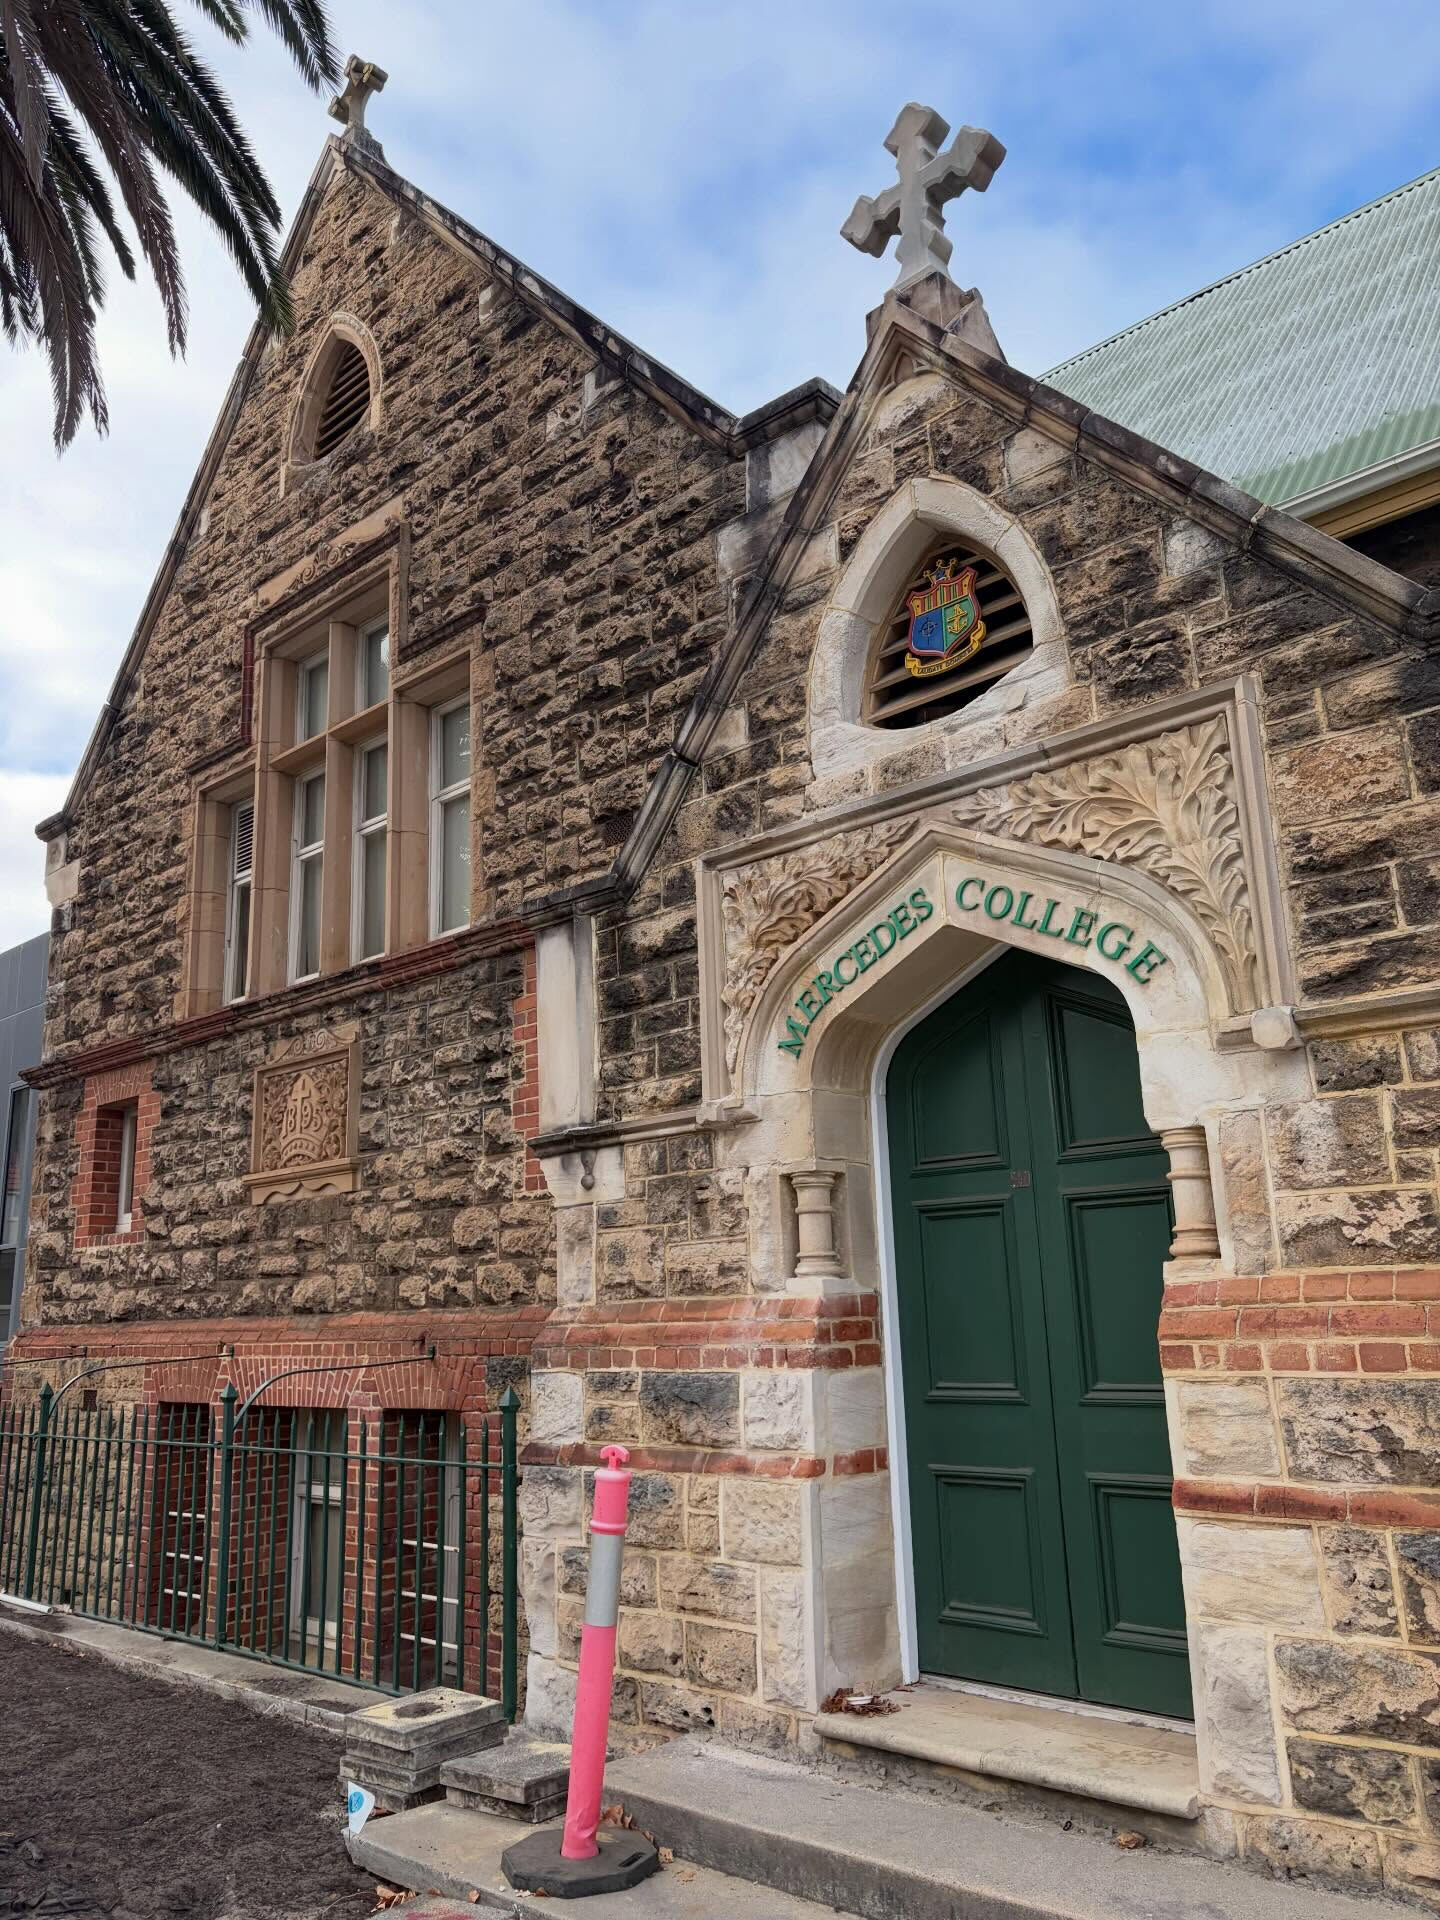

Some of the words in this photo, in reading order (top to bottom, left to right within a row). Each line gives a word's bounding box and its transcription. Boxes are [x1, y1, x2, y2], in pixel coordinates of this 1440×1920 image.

[777, 887, 934, 1059] MERCEDES
[955, 877, 1169, 985] COLLEGE
[282, 1102, 323, 1139] 1895
